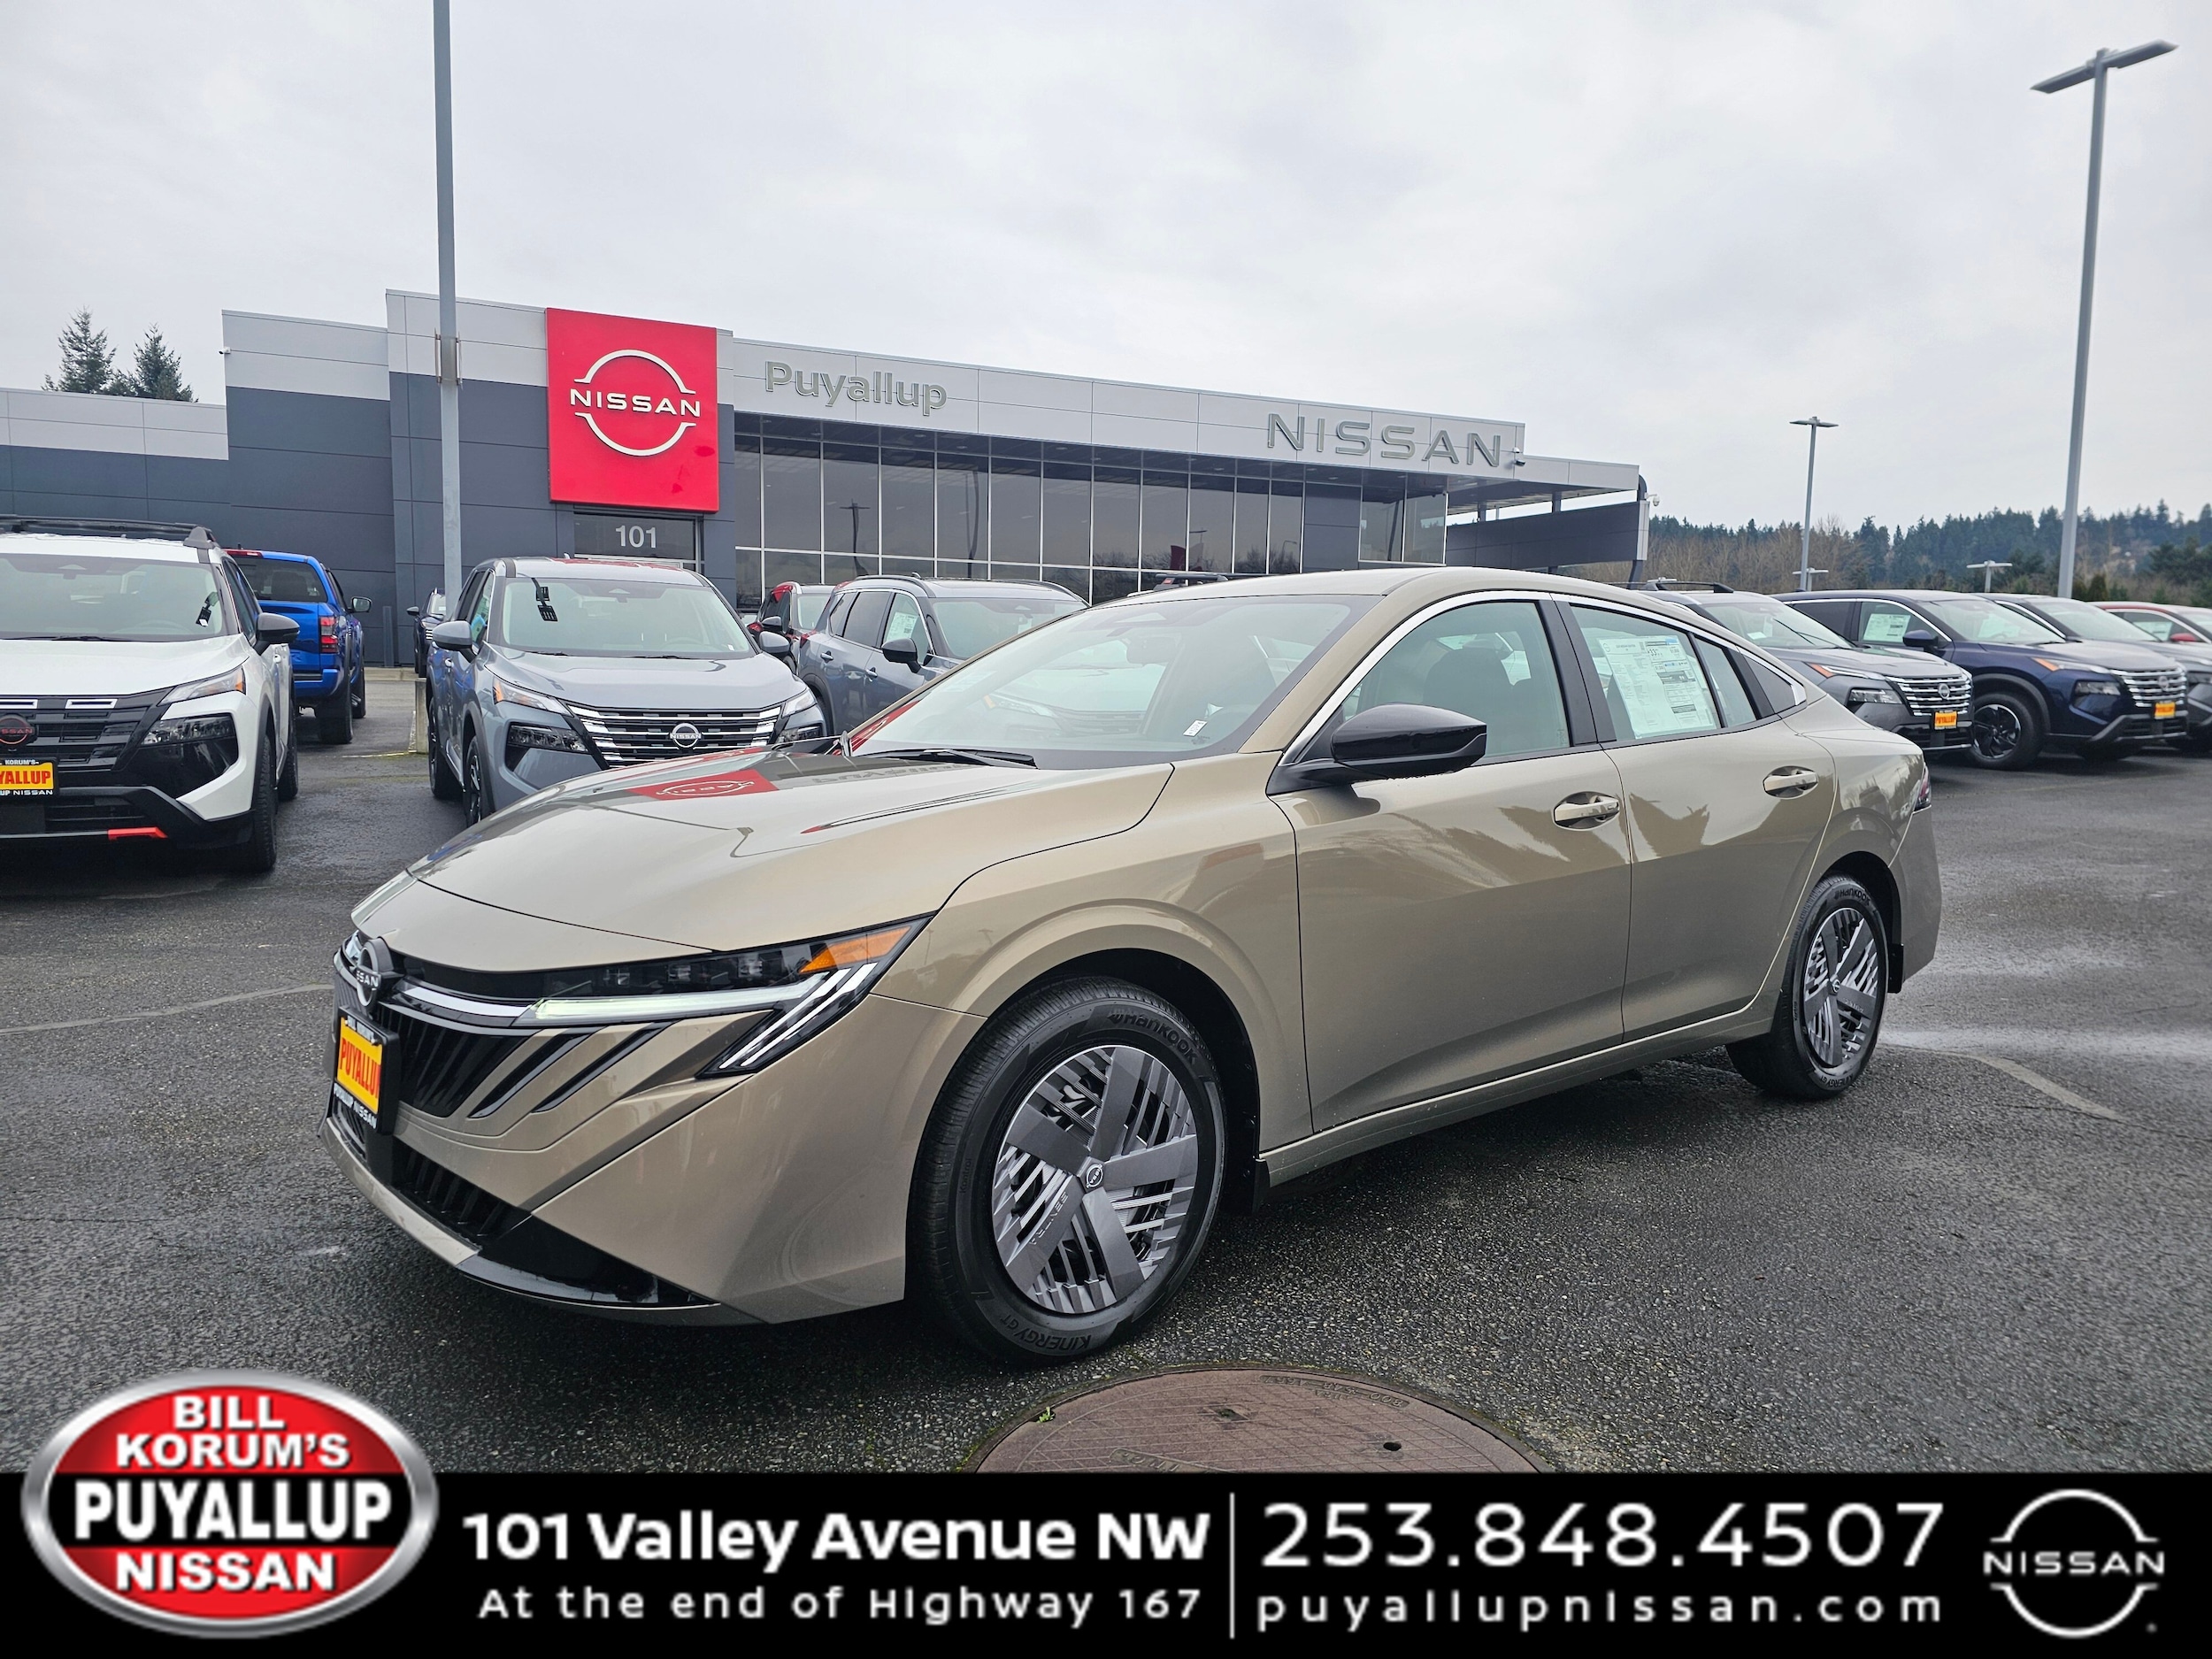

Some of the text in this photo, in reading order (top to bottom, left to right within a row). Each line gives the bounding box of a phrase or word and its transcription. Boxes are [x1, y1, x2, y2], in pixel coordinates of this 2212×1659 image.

[570, 388, 701, 418] NISSAN
[765, 361, 947, 417] Puyallup
[1267, 413, 1502, 467] NISSAN
[615, 525, 657, 549] 101
[999, 1314, 1092, 1351] KINERGY GT
